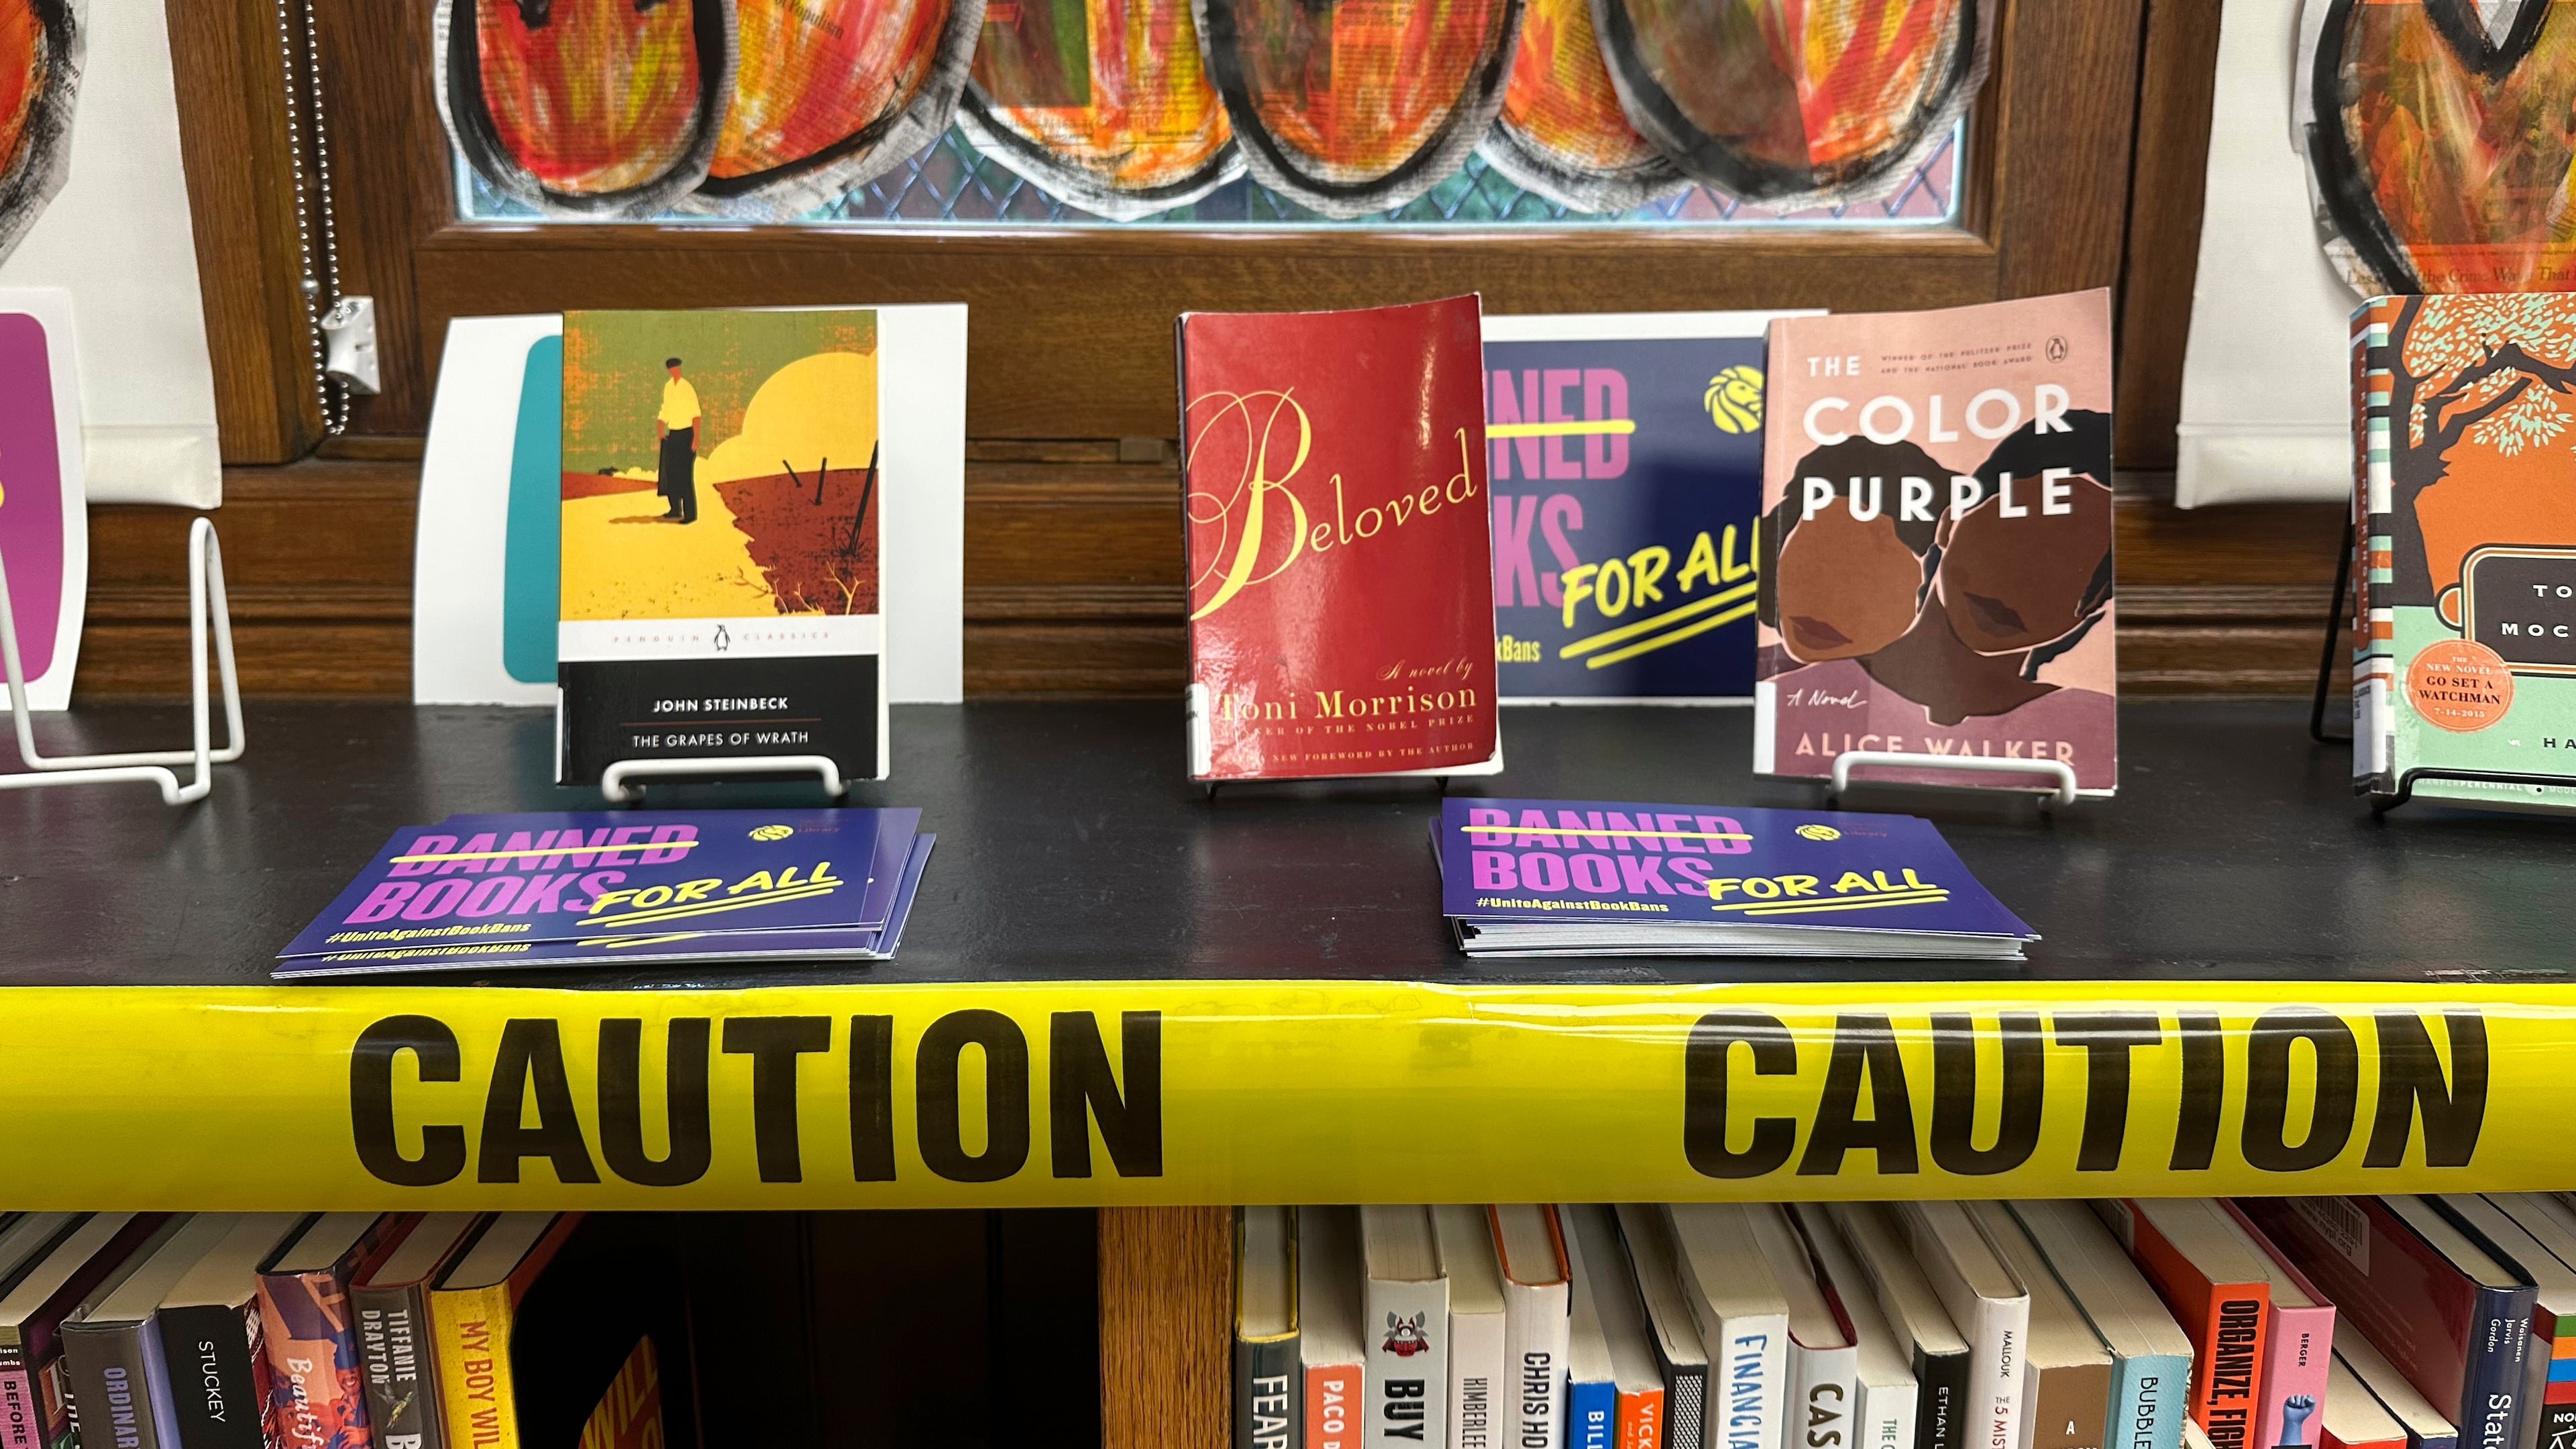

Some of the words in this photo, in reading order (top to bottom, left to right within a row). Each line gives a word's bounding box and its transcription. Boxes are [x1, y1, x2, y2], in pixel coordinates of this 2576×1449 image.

[1807, 356, 1862, 377] THE
[1925, 364, 1966, 372] NATIONAL
[1973, 360, 1996, 368] BOOK
[2004, 356, 2032, 365] AWARD
[1960, 347, 2000, 357] PULITZER
[2006, 343, 2031, 351] PRIZE
[1484, 368, 1630, 481] NED
[1803, 384, 2074, 446] COLOR
[1186, 386, 1477, 616] Beloved
[1802, 467, 2072, 523] PURPLE
[1561, 545, 1670, 629] FOR
[2532, 584, 2573, 598] TO
[613, 635, 700, 643] PENGUIN
[742, 632, 830, 641] CLASSICS
[2502, 623, 2569, 638] MOC
[1376, 659, 1399, 681] A
[1408, 660, 1449, 679] novel
[1454, 656, 1474, 680] by
[2426, 663, 2451, 672] NEW
[2456, 665, 2493, 675] NOVEL
[2426, 676, 2447, 686] GO
[2452, 678, 2479, 688] SET
[2485, 680, 2493, 690] A
[653, 699, 698, 713] JOHN
[704, 696, 790, 712] STEINBECK
[1215, 691, 1297, 721] Toni
[1315, 685, 1477, 719] Morrison
[1786, 688, 1803, 707] A
[1808, 689, 1868, 709] Novel
[2418, 690, 2501, 704] WATCHMAN
[2434, 708, 2485, 718] 7-14-2015
[633, 735, 660, 749] THE
[666, 733, 724, 748] GRAPES
[729, 732, 751, 746] OF
[756, 730, 809, 745] WRATH
[1295, 726, 1315, 735] OF
[1326, 724, 1356, 734] THE
[1366, 721, 1418, 732] NOBEL
[1428, 714, 1474, 727] PRIZE
[1273, 753, 1298, 762] NEW
[1305, 750, 1373, 761] FOREWORD
[1379, 749, 1393, 757] BY
[1400, 747, 1423, 756] THE
[1428, 743, 1474, 754] AUTHOR
[1795, 731, 1903, 758] ALICE
[1923, 737, 2076, 767] WALKER
[387, 824, 698, 877] BANNED
[1468, 808, 1752, 855] BANNED
[588, 879, 722, 915] FOR
[727, 861, 837, 894] ALL
[1472, 850, 1714, 897] BOOKS
[1703, 874, 1819, 901] FOR
[1829, 867, 1937, 894] ALL
[342, 871, 626, 924] BOOKS
[1476, 896, 1669, 913] #UniteAgainstBookBans
[325, 922, 532, 944] #UniteAgainstBookBans
[348, 1008, 1163, 1187] CAUTION
[1683, 1006, 2489, 1180] CAUTION
[361, 1309, 390, 1385] DRAYTON
[388, 1309, 417, 1382] TIFFANIE
[460, 1320, 490, 1352] MY
[2298, 1333, 2310, 1367] BERGER
[2487, 1318, 2502, 1353] Gordon
[2504, 1319, 2516, 1345] Jarvis
[2515, 1317, 2528, 1362] Waisanen
[2000, 1330, 2012, 1378] MALLOUK
[2206, 1299, 2260, 1406] ORGANIZE,
[199, 1341, 226, 1423] STUCKEY
[464, 1358, 495, 1401] BOY
[1522, 1352, 1550, 1415] CHRIS
[1727, 1334, 1768, 1449] FINANCIA
[3, 1381, 28, 1444] BEFORE
[103, 1367, 140, 1449] ORDINAR
[286, 1357, 324, 1449] Beautif
[1252, 1375, 1288, 1449] FEAR
[1323, 1379, 1345, 1434] PACO
[1383, 1379, 1425, 1442] BUY
[1462, 1377, 1488, 1448] KIMBERLEE
[1807, 1383, 1844, 1448] CAS
[1935, 1386, 1949, 1438] ETHAN
[1995, 1395, 2010, 1405] THE
[1995, 1406, 2008, 1415] 5
[2134, 1377, 2159, 1449] BUBBLE
[2553, 1413, 2576, 1424] NO
[1521, 1421, 1549, 1449] HO
[1882, 1419, 1898, 1442] THE
[2065, 1420, 2075, 1435] A
